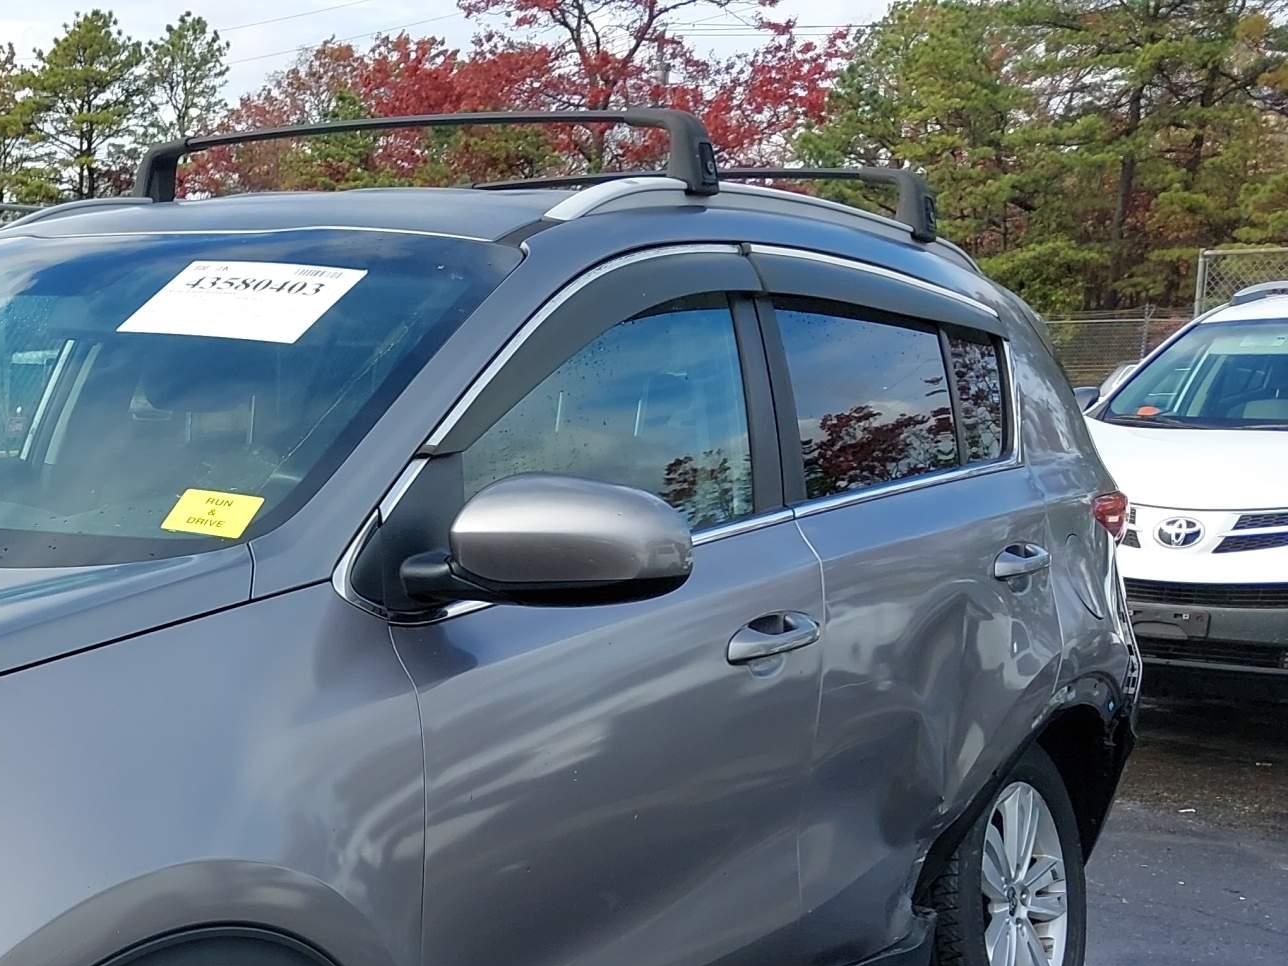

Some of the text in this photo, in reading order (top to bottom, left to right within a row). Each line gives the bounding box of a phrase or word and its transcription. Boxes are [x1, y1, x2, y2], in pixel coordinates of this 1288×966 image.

[185, 276, 326, 296] 43580403
[205, 497, 234, 508] RUN
[208, 509, 216, 517] &
[185, 516, 227, 528] DRIVE
